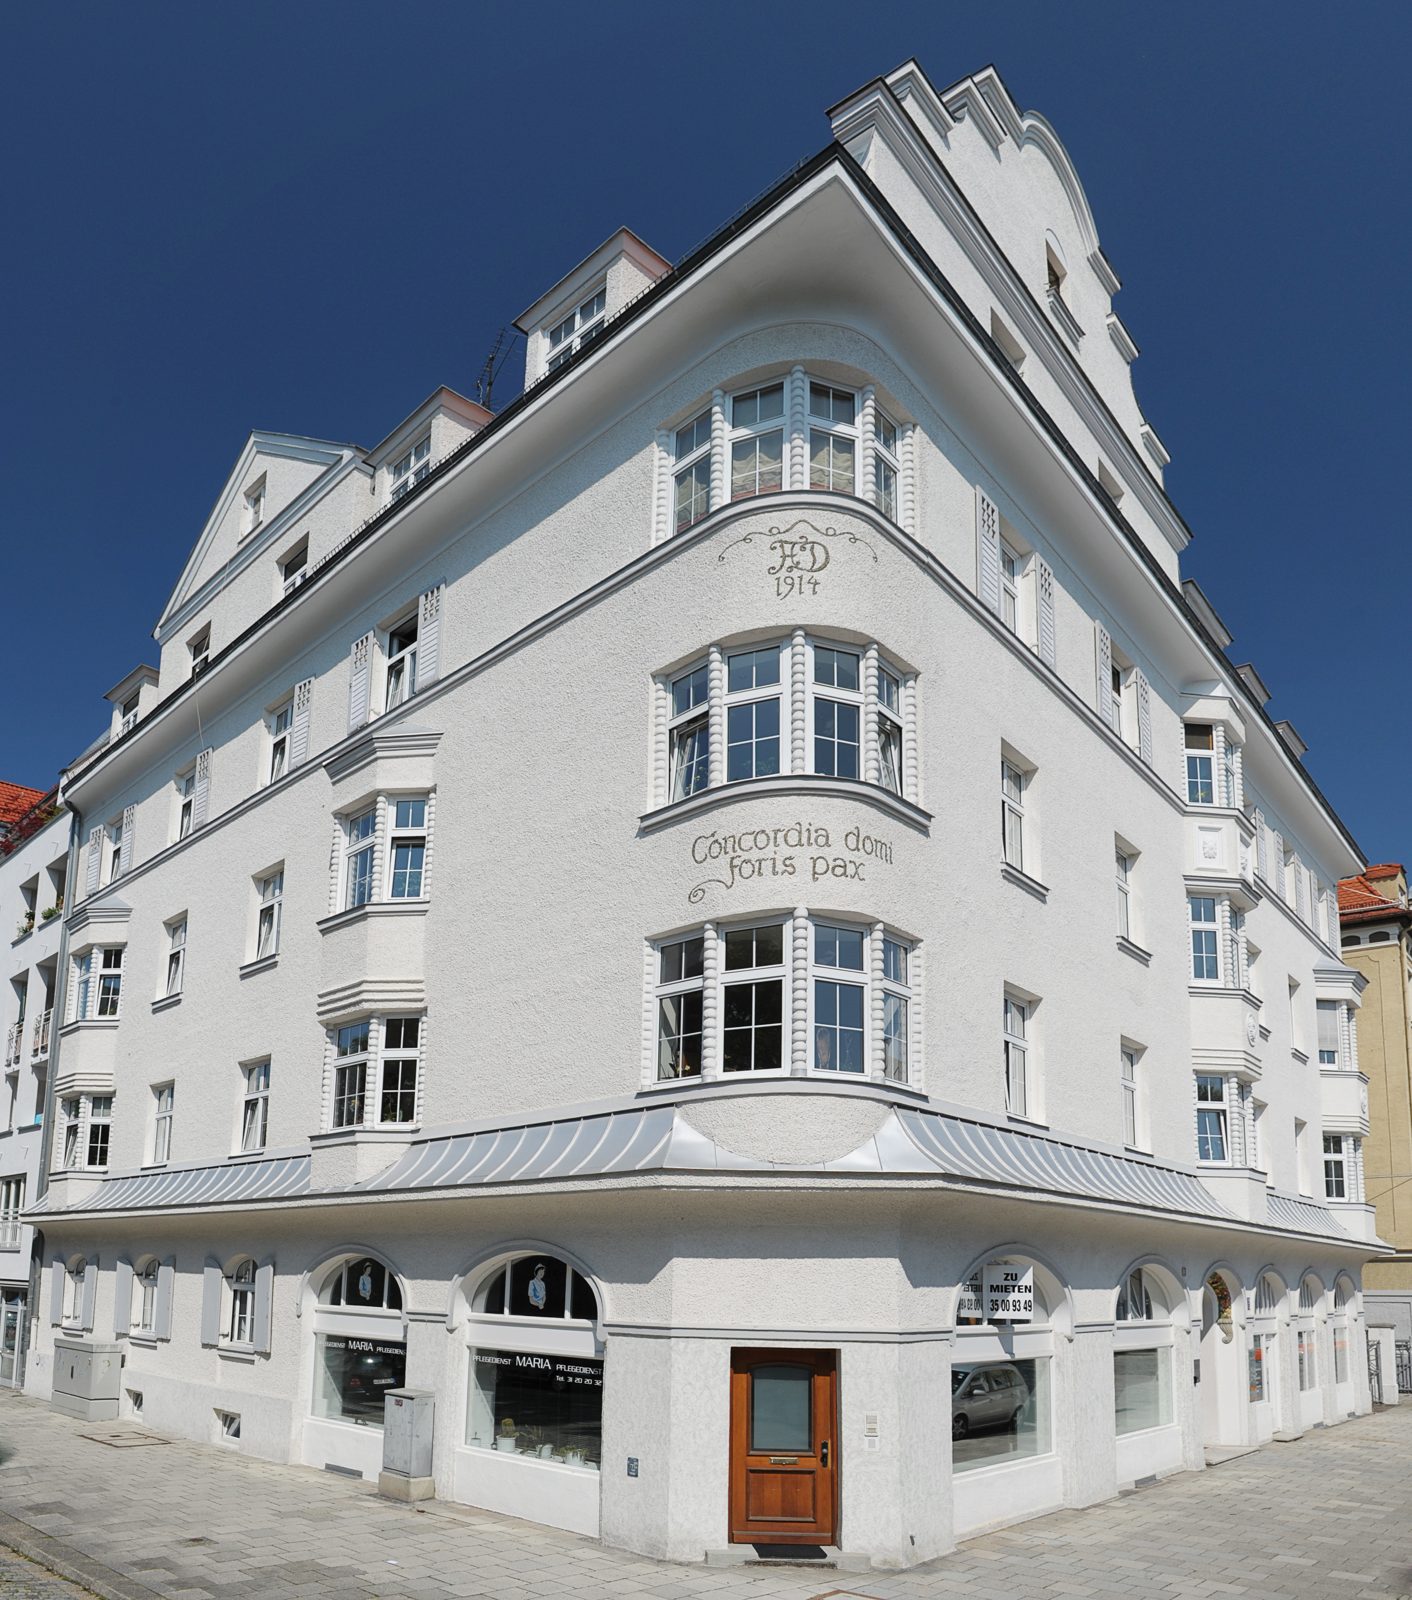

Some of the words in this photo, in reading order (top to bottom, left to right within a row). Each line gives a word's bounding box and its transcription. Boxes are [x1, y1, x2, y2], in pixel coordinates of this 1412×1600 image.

[775, 575, 821, 600] 1914
[692, 822, 831, 865] Concordia
[844, 826, 893, 865] domi
[810, 856, 865, 882] pax
[1003, 1272, 1018, 1282] ZU
[989, 1284, 1032, 1294] MIETEN
[990, 1299, 999, 1312] 35
[1001, 1299, 1010, 1312] 00
[1012, 1299, 1021, 1312] 93
[1023, 1299, 1032, 1312] 49
[348, 1340, 374, 1352] MARIA
[472, 1355, 512, 1365] PFLEGEDIENST
[515, 1355, 551, 1370] MARIA
[556, 1364, 602, 1375] PFLEGEDIENST
